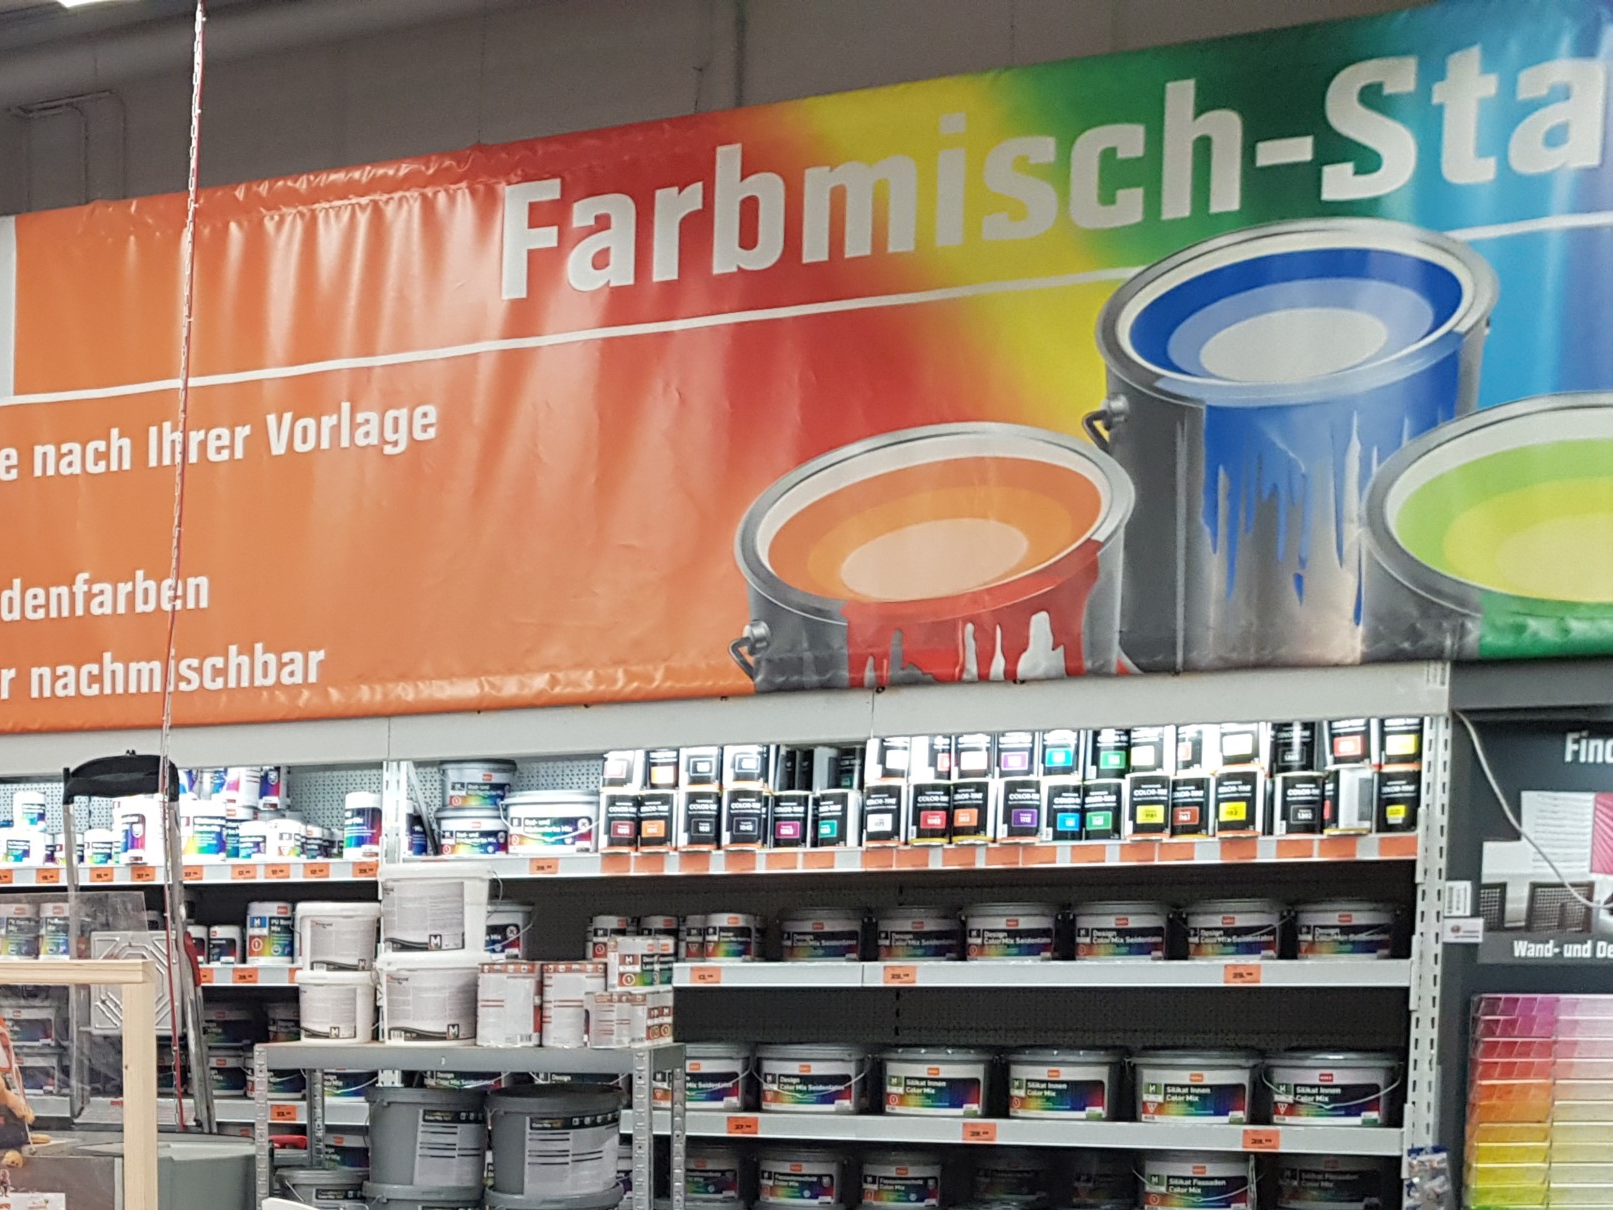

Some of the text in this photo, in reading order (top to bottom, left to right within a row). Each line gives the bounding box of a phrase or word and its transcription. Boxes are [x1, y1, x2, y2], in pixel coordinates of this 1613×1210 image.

[33, 427, 131, 479] nach
[148, 413, 252, 468] Ihrer
[265, 402, 438, 457] Vorlage
[1514, 940, 1559, 959] Wand-
[1563, 939, 1593, 959] und
